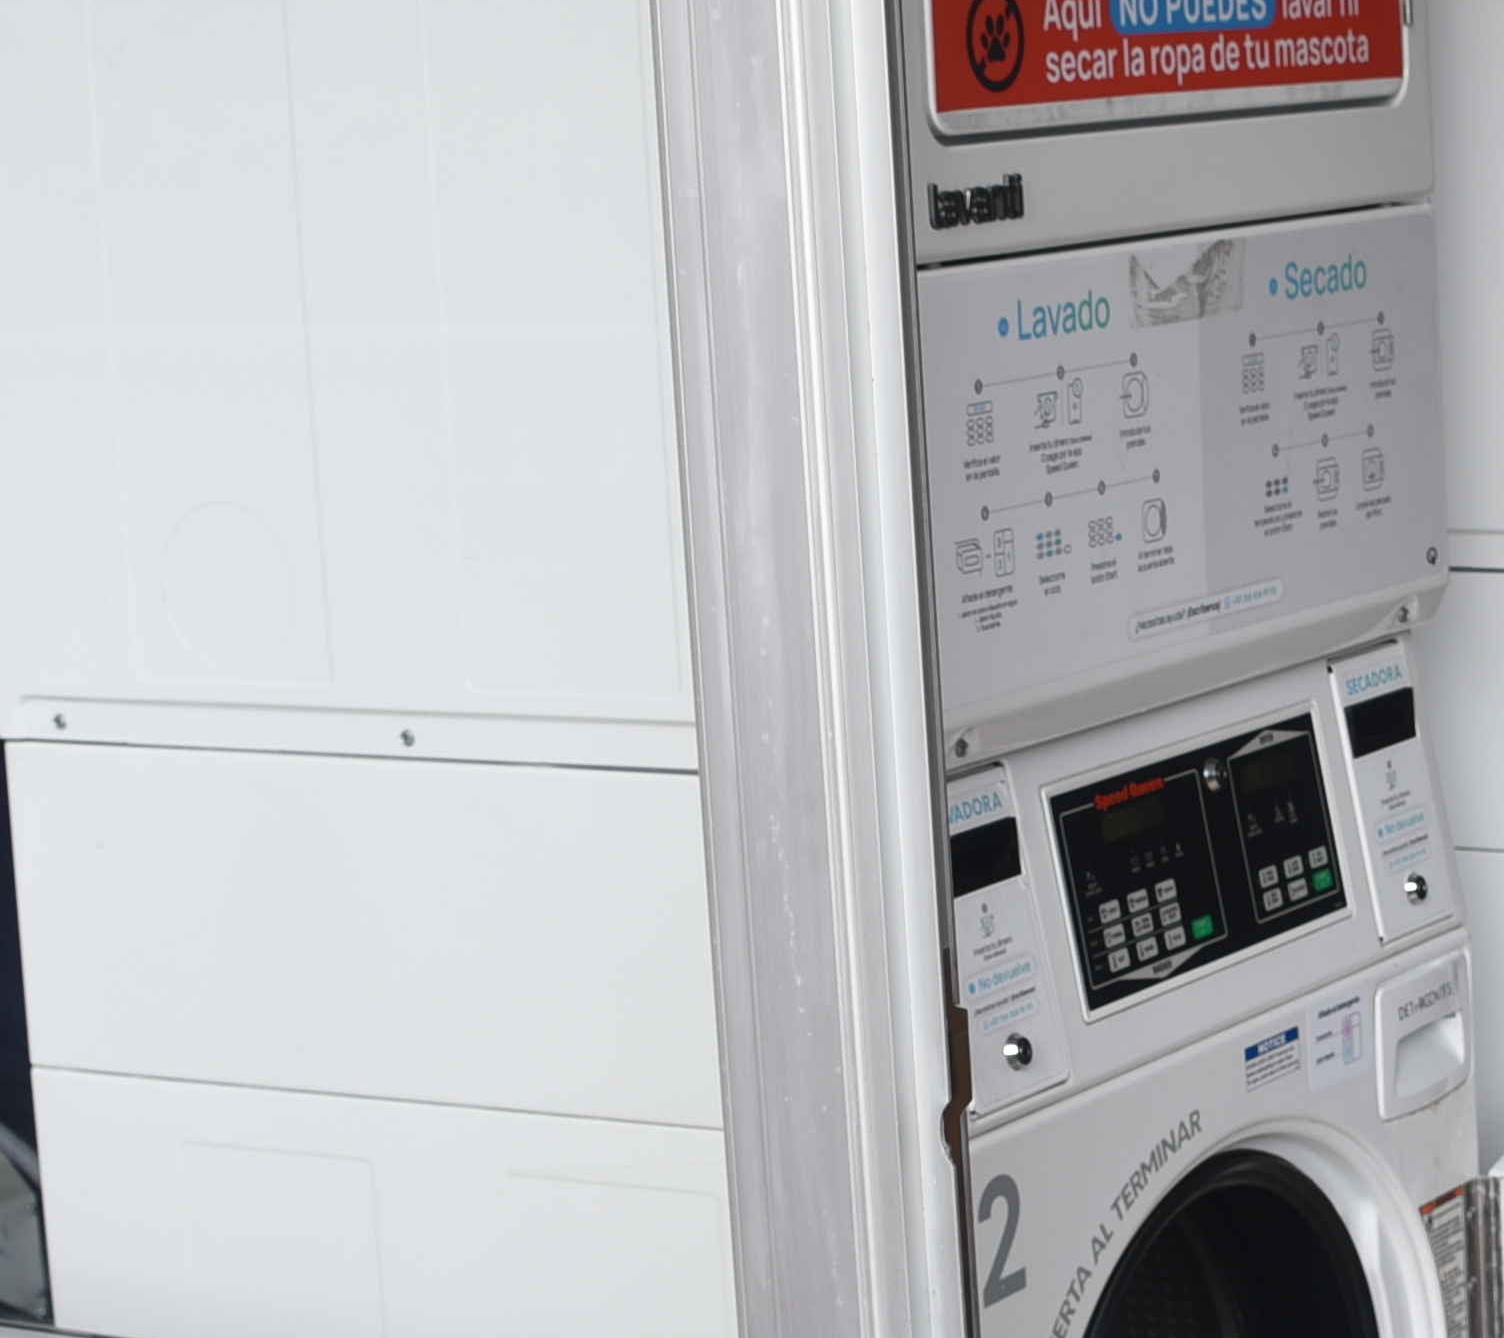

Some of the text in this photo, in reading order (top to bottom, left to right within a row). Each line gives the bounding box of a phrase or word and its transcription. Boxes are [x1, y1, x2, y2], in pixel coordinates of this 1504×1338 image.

[1045, 29, 1370, 86] secar la ropa de tu mascota
[1284, 254, 1368, 301] Secado
[1016, 288, 1111, 342] Lavado
[1345, 663, 1403, 696] SECADORA
[1093, 776, 1165, 812] Speed Queen
[1090, 1221, 1116, 1265] AL
[1108, 1109, 1203, 1222] TERMINAR
[977, 1173, 1028, 1309] 2
